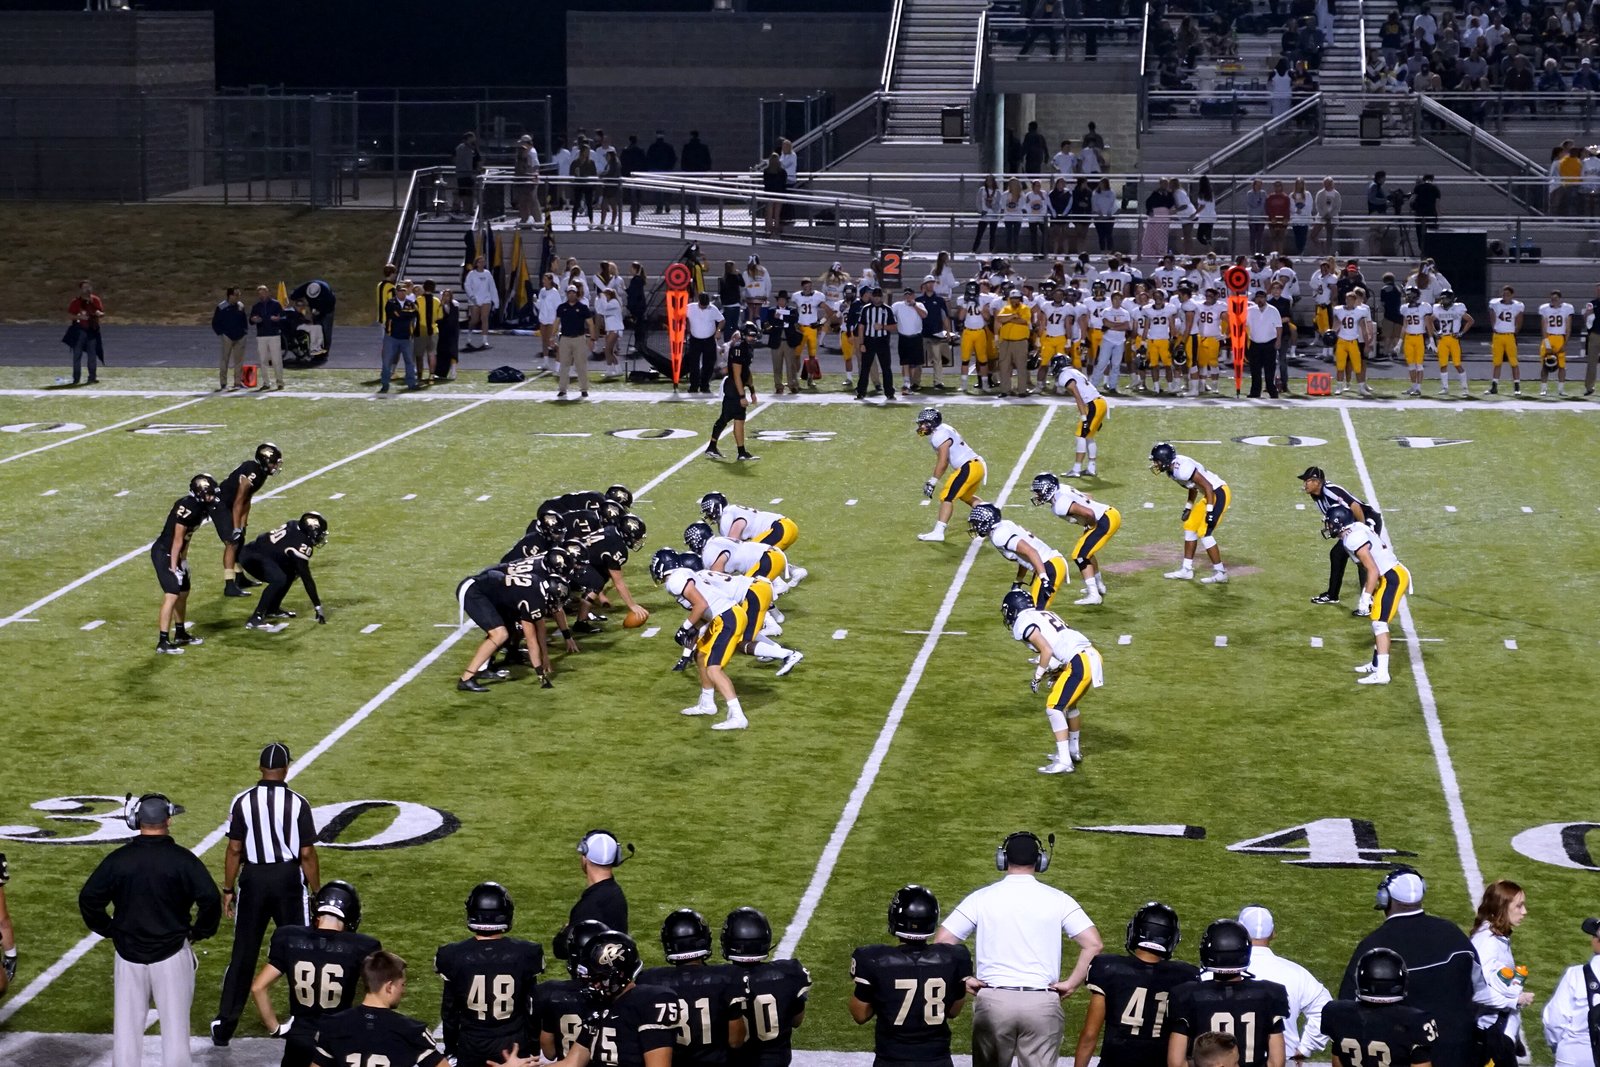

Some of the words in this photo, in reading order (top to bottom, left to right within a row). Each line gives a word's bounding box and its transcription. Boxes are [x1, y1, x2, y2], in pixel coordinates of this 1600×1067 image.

[884, 253, 900, 274] 2
[1106, 278, 1121, 292] 70
[801, 303, 812, 314] 31
[1048, 313, 1062, 324] 47
[1200, 312, 1213, 324] 96
[1341, 316, 1355, 329] 48
[1498, 311, 1512, 322] 42
[1549, 314, 1563, 327] 28
[1440, 319, 1455, 334] 27
[1309, 375, 1330, 392] 40
[176, 505, 192, 519] 27
[299, 543, 312, 556] 20
[530, 608, 542, 620] 12
[294, 960, 344, 1009] 86
[467, 974, 515, 1020] 48
[893, 977, 947, 1026] 78
[655, 1003, 678, 1023] 75
[1121, 986, 1170, 1038] 41
